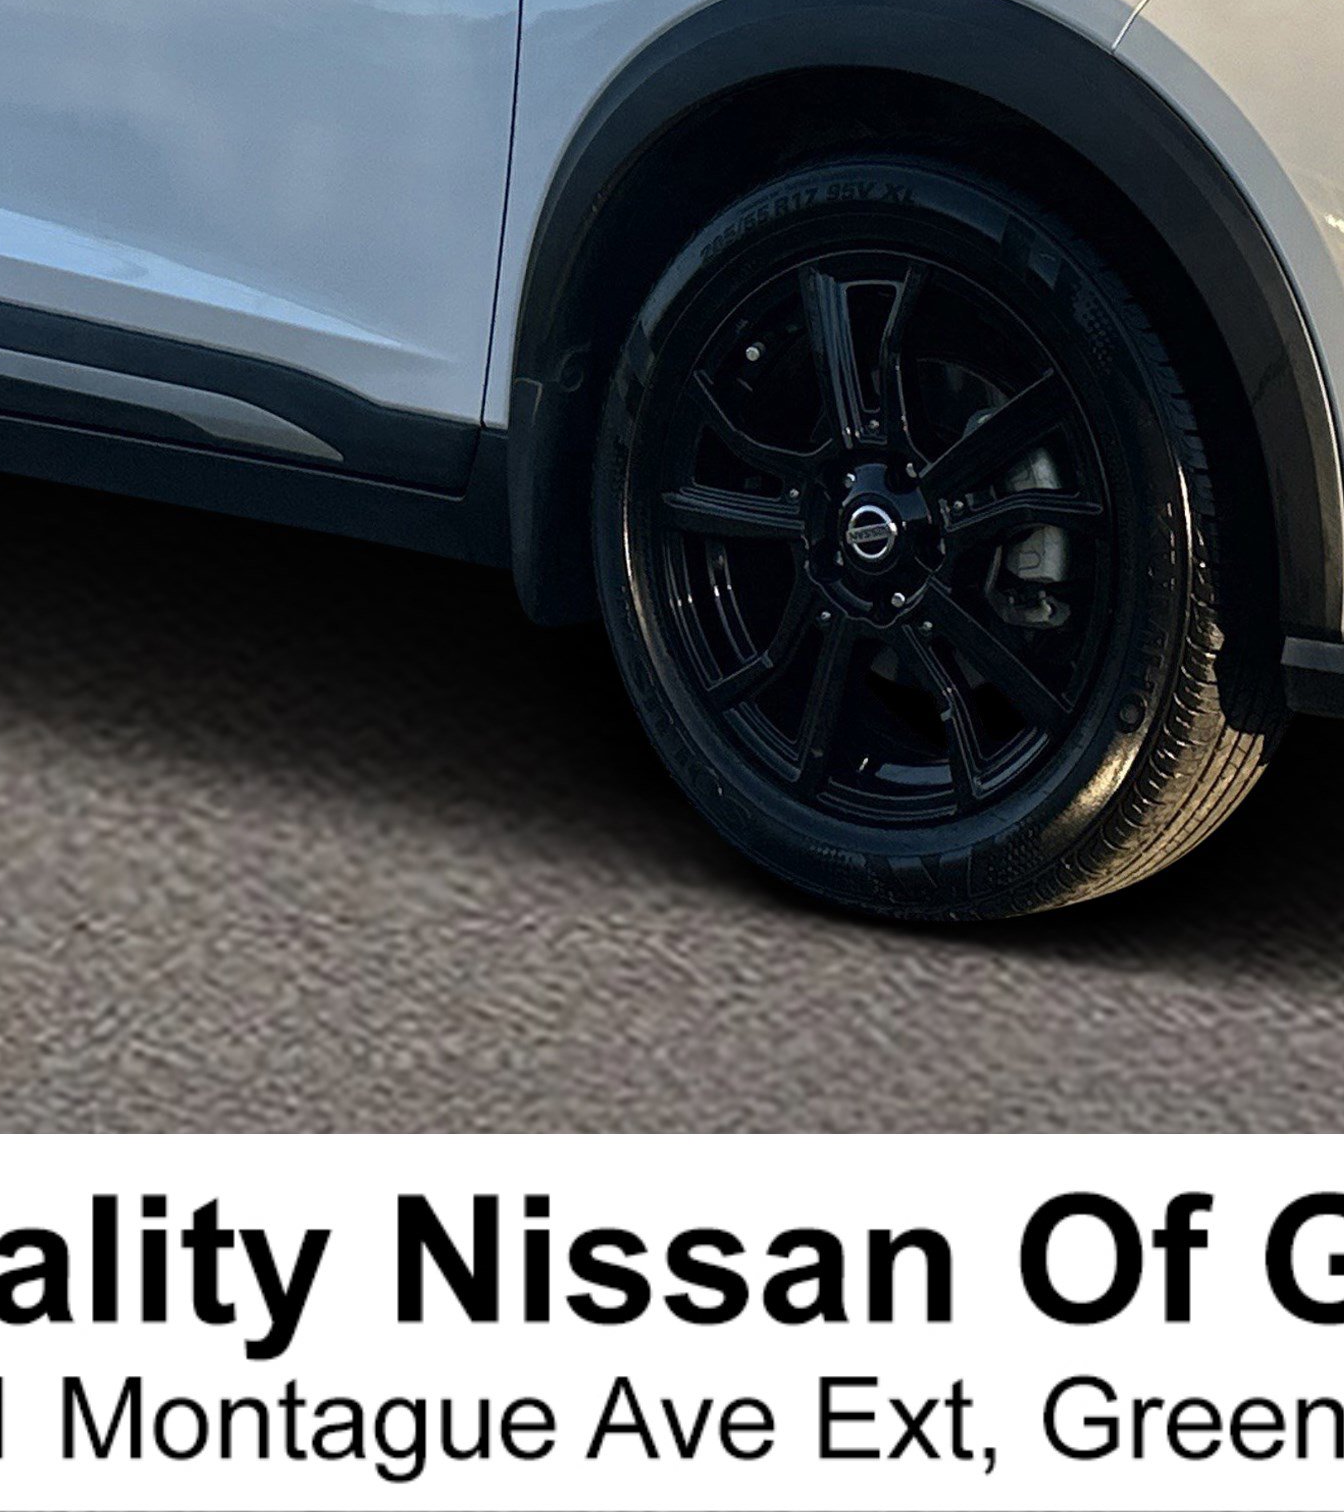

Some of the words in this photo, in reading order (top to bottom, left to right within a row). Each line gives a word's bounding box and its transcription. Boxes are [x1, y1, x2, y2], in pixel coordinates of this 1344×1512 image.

[771, 187, 820, 216] R17
[824, 181, 876, 202] 95V
[881, 181, 918, 205] XL
